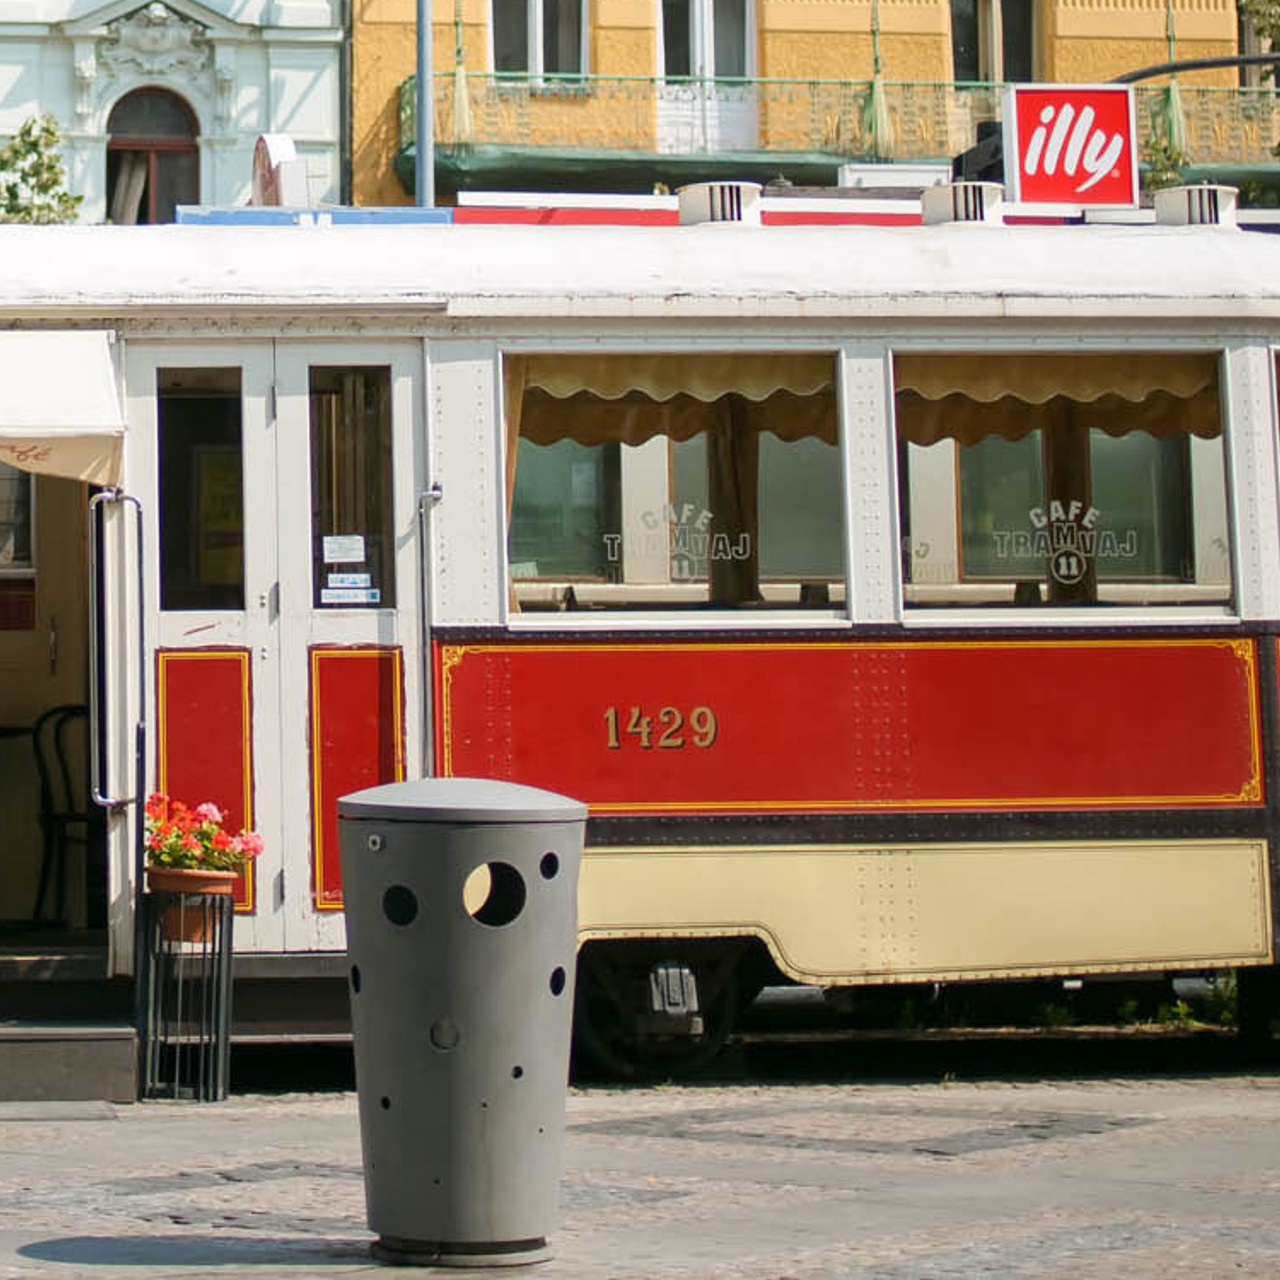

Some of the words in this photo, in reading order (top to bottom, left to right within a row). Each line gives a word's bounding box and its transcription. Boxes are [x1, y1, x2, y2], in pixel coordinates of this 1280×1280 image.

[1024, 102, 1124, 193] illy
[1029, 499, 1101, 529] CAFE
[994, 521, 1139, 559] TRAMVAJ
[603, 705, 718, 750] 1429
